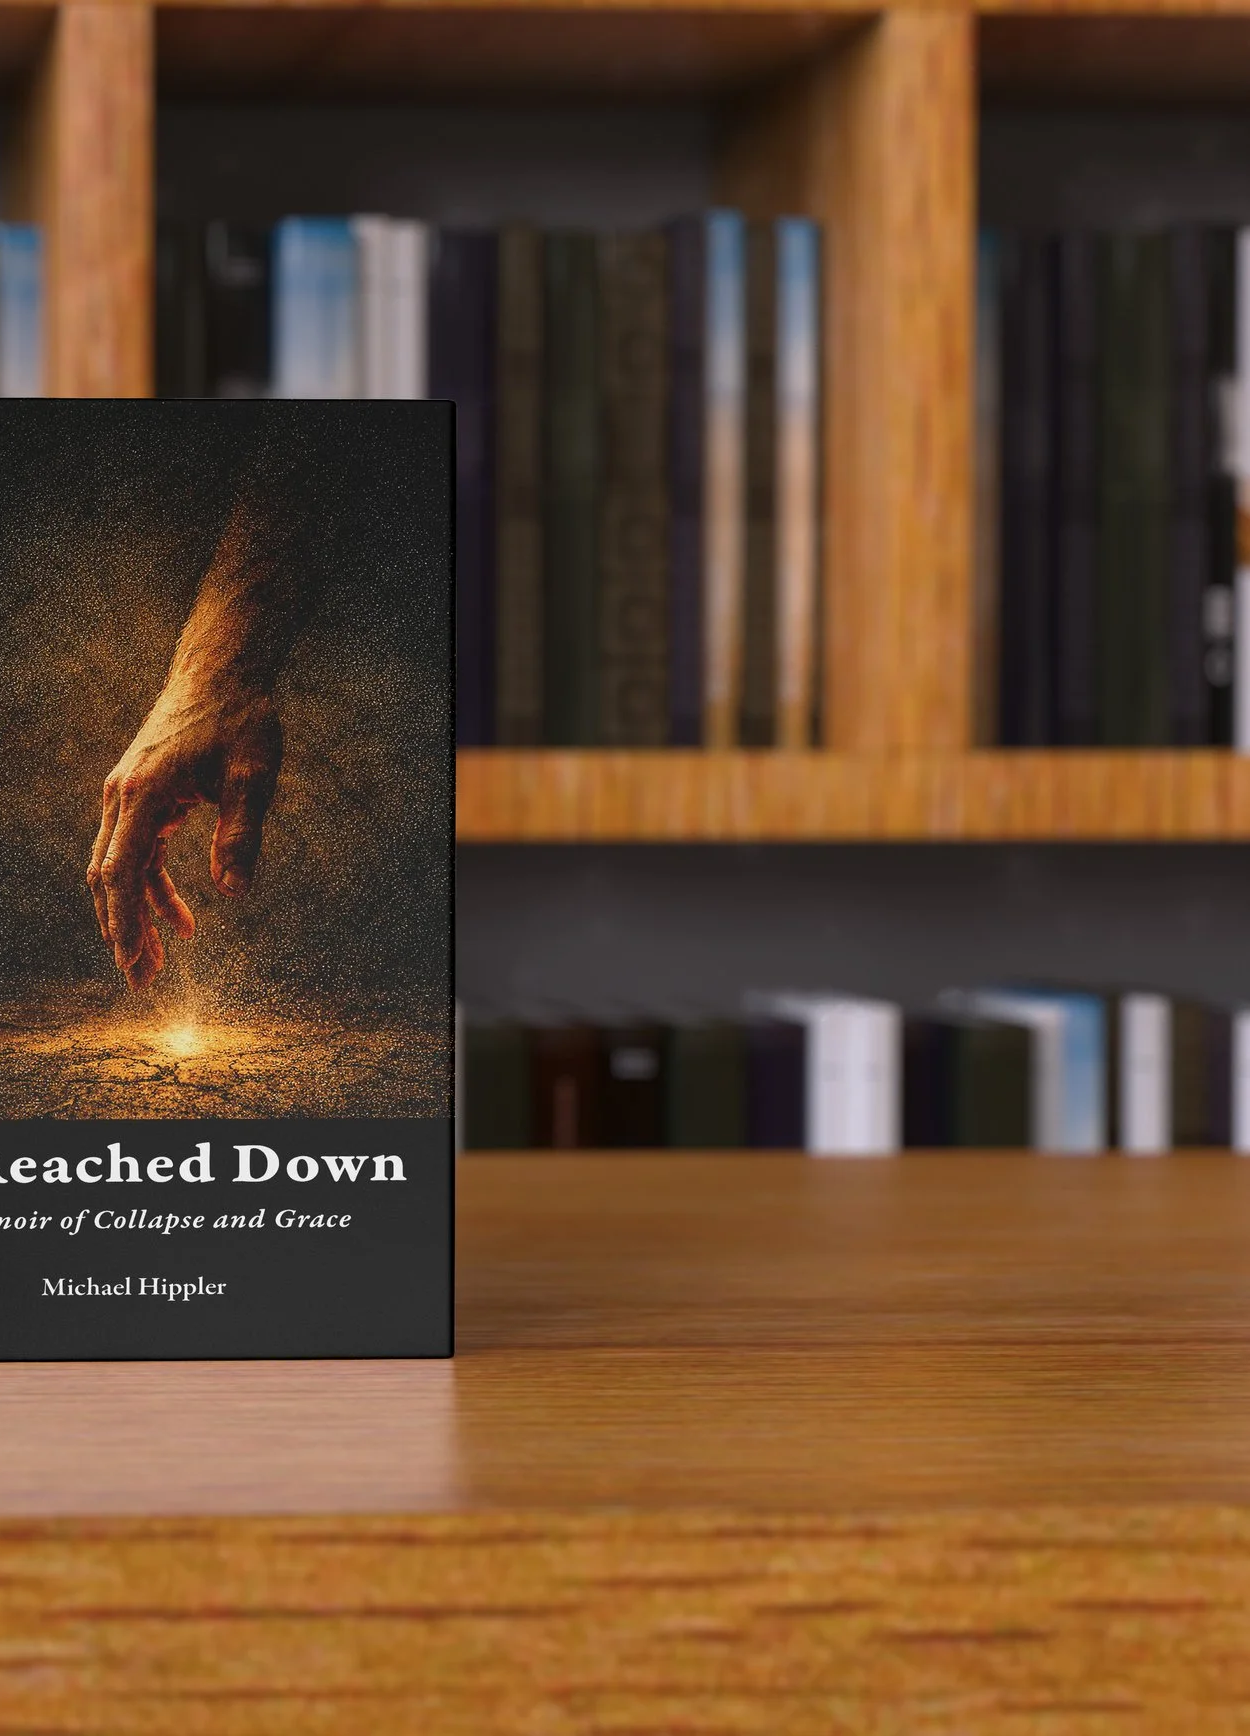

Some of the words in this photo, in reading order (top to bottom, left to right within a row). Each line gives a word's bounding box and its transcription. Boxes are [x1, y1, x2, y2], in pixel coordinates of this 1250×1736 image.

[231, 1144, 408, 1183] Down
[59, 1208, 91, 1236] of
[93, 1208, 206, 1235] Collapse
[212, 1208, 266, 1229] and
[274, 1208, 352, 1229] Grace
[41, 1276, 132, 1297] Michael
[137, 1275, 227, 1302] Hippler
